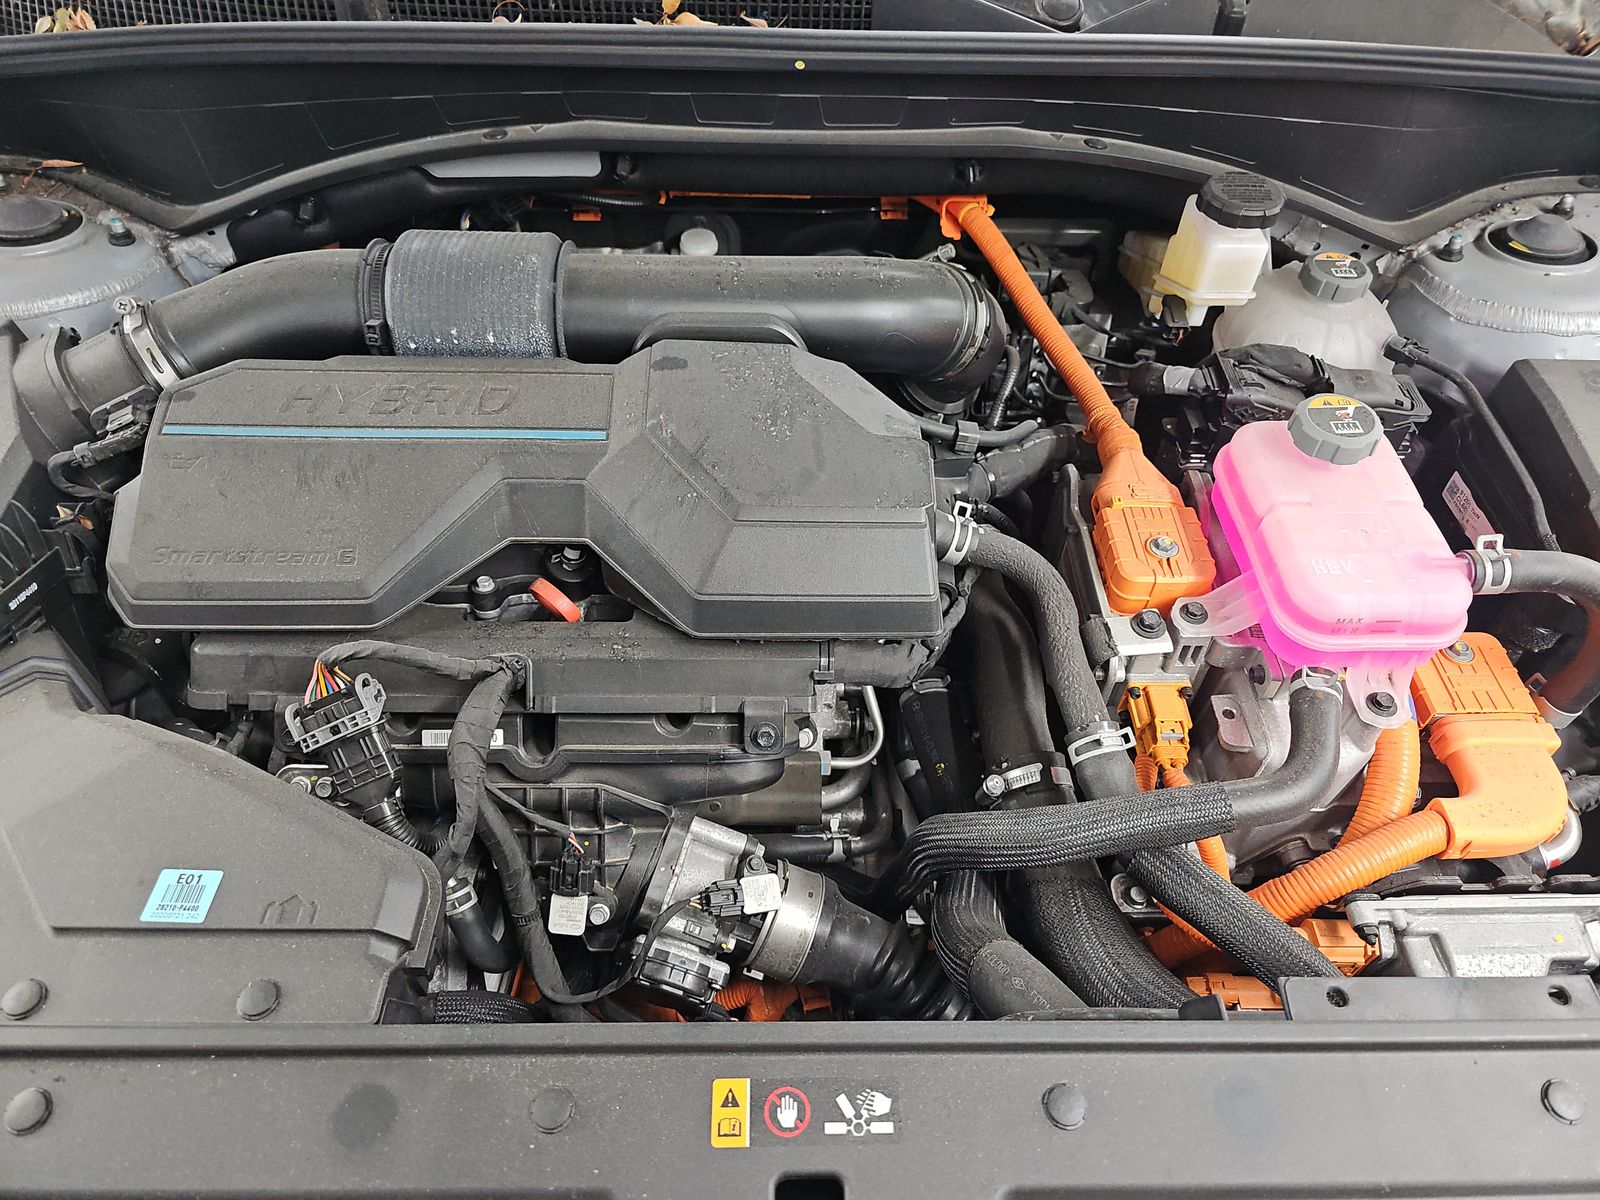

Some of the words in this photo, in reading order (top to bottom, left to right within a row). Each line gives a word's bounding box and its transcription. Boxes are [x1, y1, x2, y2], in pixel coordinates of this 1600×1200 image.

[277, 384, 518, 415] HYBRID
[150, 546, 330, 567] Smartstream
[1311, 558, 1355, 575] HEV
[1335, 617, 1365, 625] MAX
[1330, 627, 1359, 635] MIN
[155, 903, 200, 912] 28210-P4400
